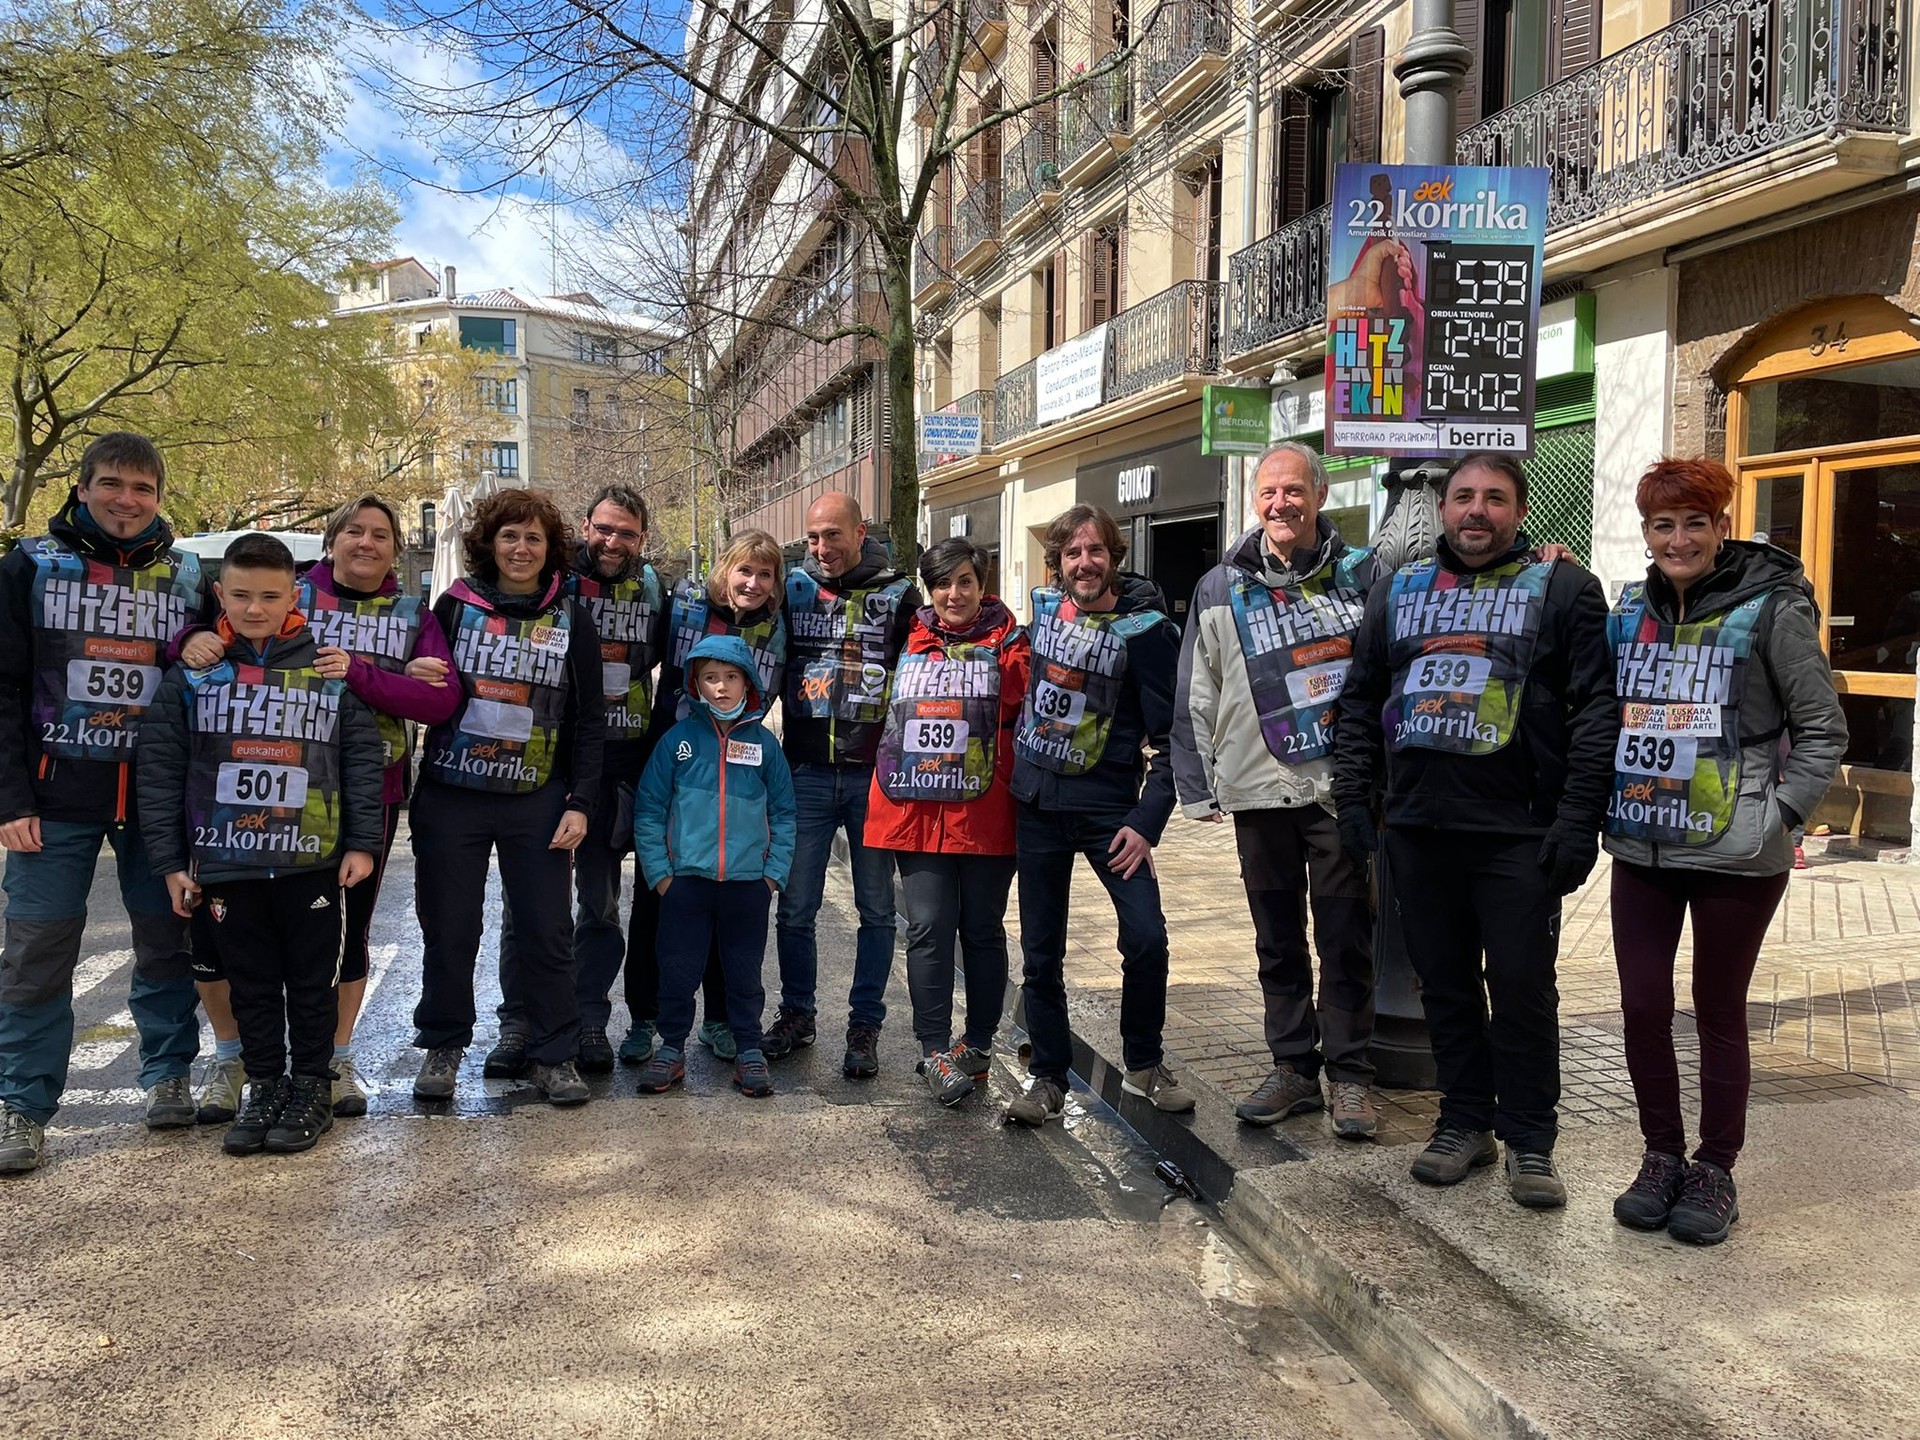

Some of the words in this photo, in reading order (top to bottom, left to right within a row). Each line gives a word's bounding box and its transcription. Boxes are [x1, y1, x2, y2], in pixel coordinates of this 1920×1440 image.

[1413, 175, 1454, 201] aek
[1347, 229, 1386, 238] Amurriotik
[1388, 230, 1427, 238] Donostiara
[1456, 260, 1528, 305] 539
[1444, 319, 1524, 359] 12:48
[1809, 321, 1849, 356] 34
[924, 416, 943, 426] CENTRO
[1218, 417, 1264, 428] IBERDROLA
[1335, 432, 1386, 443] NAFARROAKO
[1450, 427, 1516, 447] berria
[1118, 465, 1151, 503] GOIKO
[90, 645, 137, 656] euskaltel
[1297, 646, 1337, 662] euskaltel
[1309, 672, 1342, 686] EUSKARA
[1419, 659, 1470, 688] 539
[87, 666, 144, 700] 539
[479, 685, 516, 697] euskaltel
[1039, 687, 1072, 719] 539
[1416, 694, 1447, 714] aek
[1631, 706, 1666, 717] EUSKARA
[1671, 708, 1712, 716] EUSKARA
[89, 708, 125, 727] aek
[1627, 722, 1646, 730] LORTU
[1673, 715, 1710, 723] OFIZIALA
[918, 723, 955, 748] 539
[236, 746, 284, 757] euskaltel
[470, 741, 500, 759] aek
[730, 743, 757, 752] EUSKARA
[1623, 735, 1676, 772] 539
[917, 756, 942, 772] aek
[236, 769, 288, 802] 501
[1623, 778, 1655, 802] aek
[236, 809, 269, 829] aek
